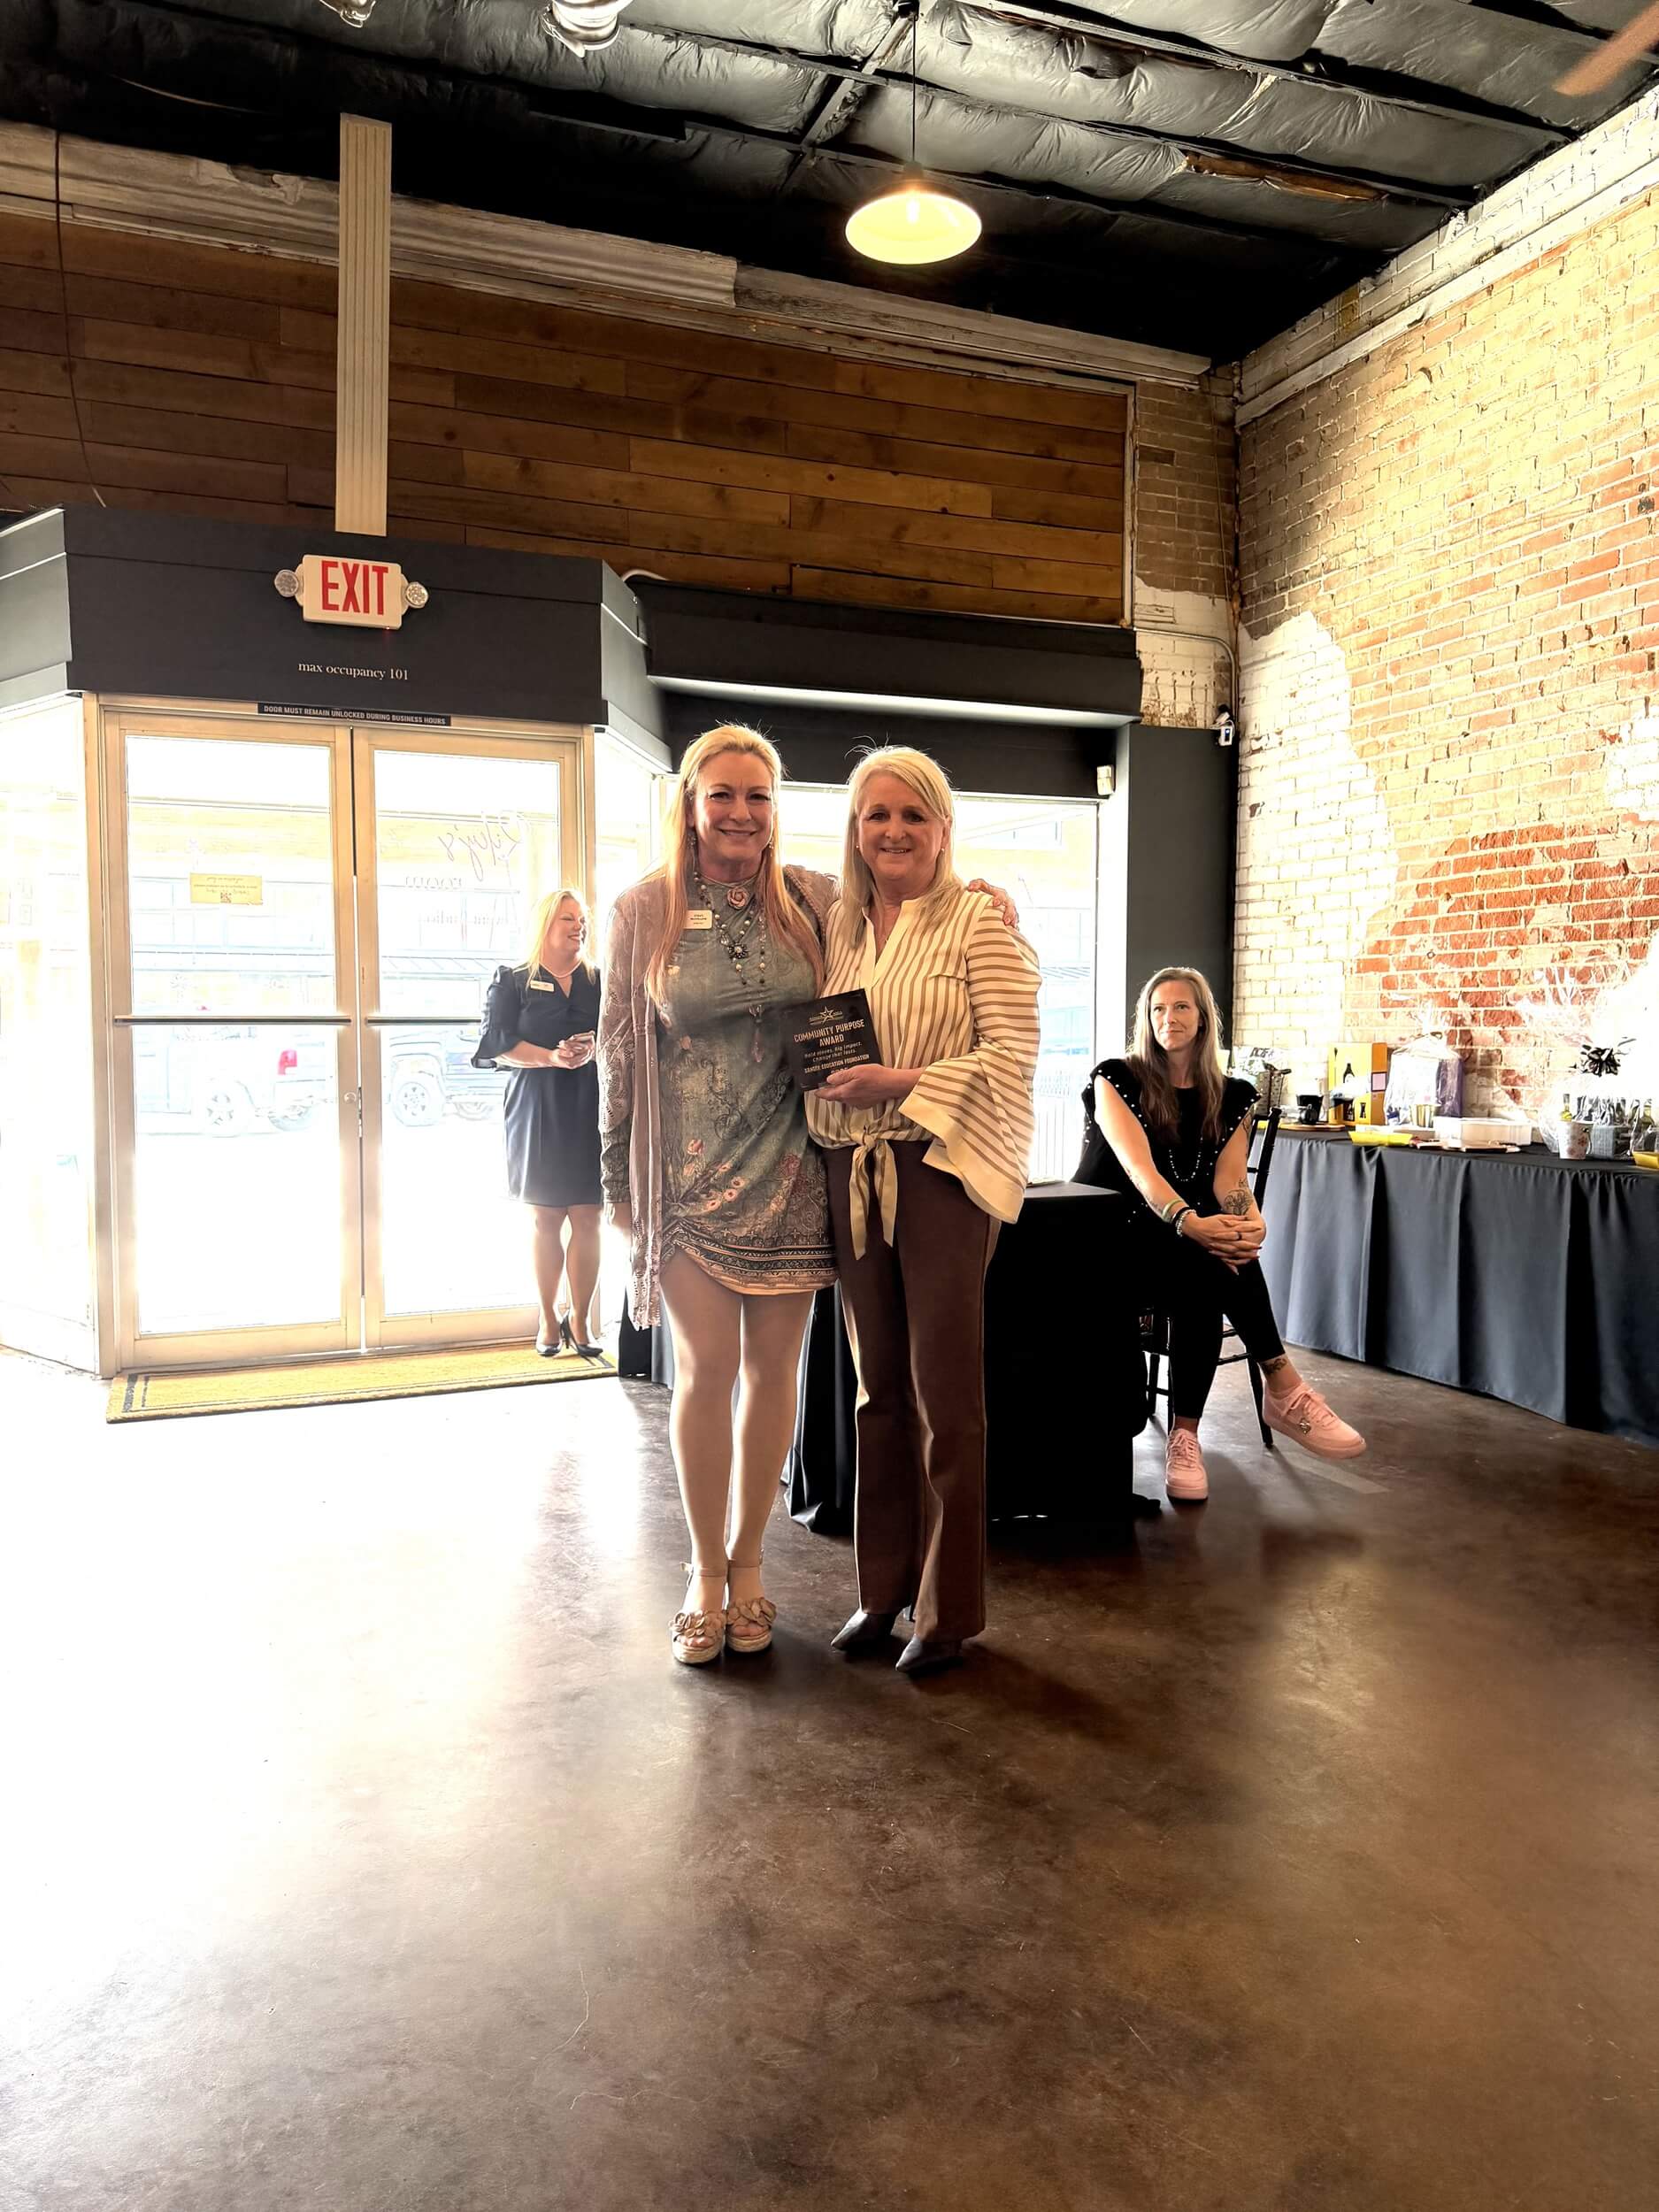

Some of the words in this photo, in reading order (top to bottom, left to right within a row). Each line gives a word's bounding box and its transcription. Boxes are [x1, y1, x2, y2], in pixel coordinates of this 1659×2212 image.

[321, 560, 388, 616] EXIT
[298, 663, 323, 673] max
[326, 665, 386, 680] occupancy
[389, 668, 409, 680] 101
[264, 705, 283, 714] DOOR
[303, 708, 329, 717] REMAIN
[331, 710, 365, 719] UNLOCKED
[366, 712, 390, 721] DURING
[391, 714, 423, 723] BUSINESS
[424, 716, 446, 726] HOURS
[794, 1026, 833, 1042] COMMUNITY
[835, 1019, 864, 1033] PURPOSE
[819, 1034, 844, 1047] AWARD
[844, 1054, 870, 1064] FOUNDATION
